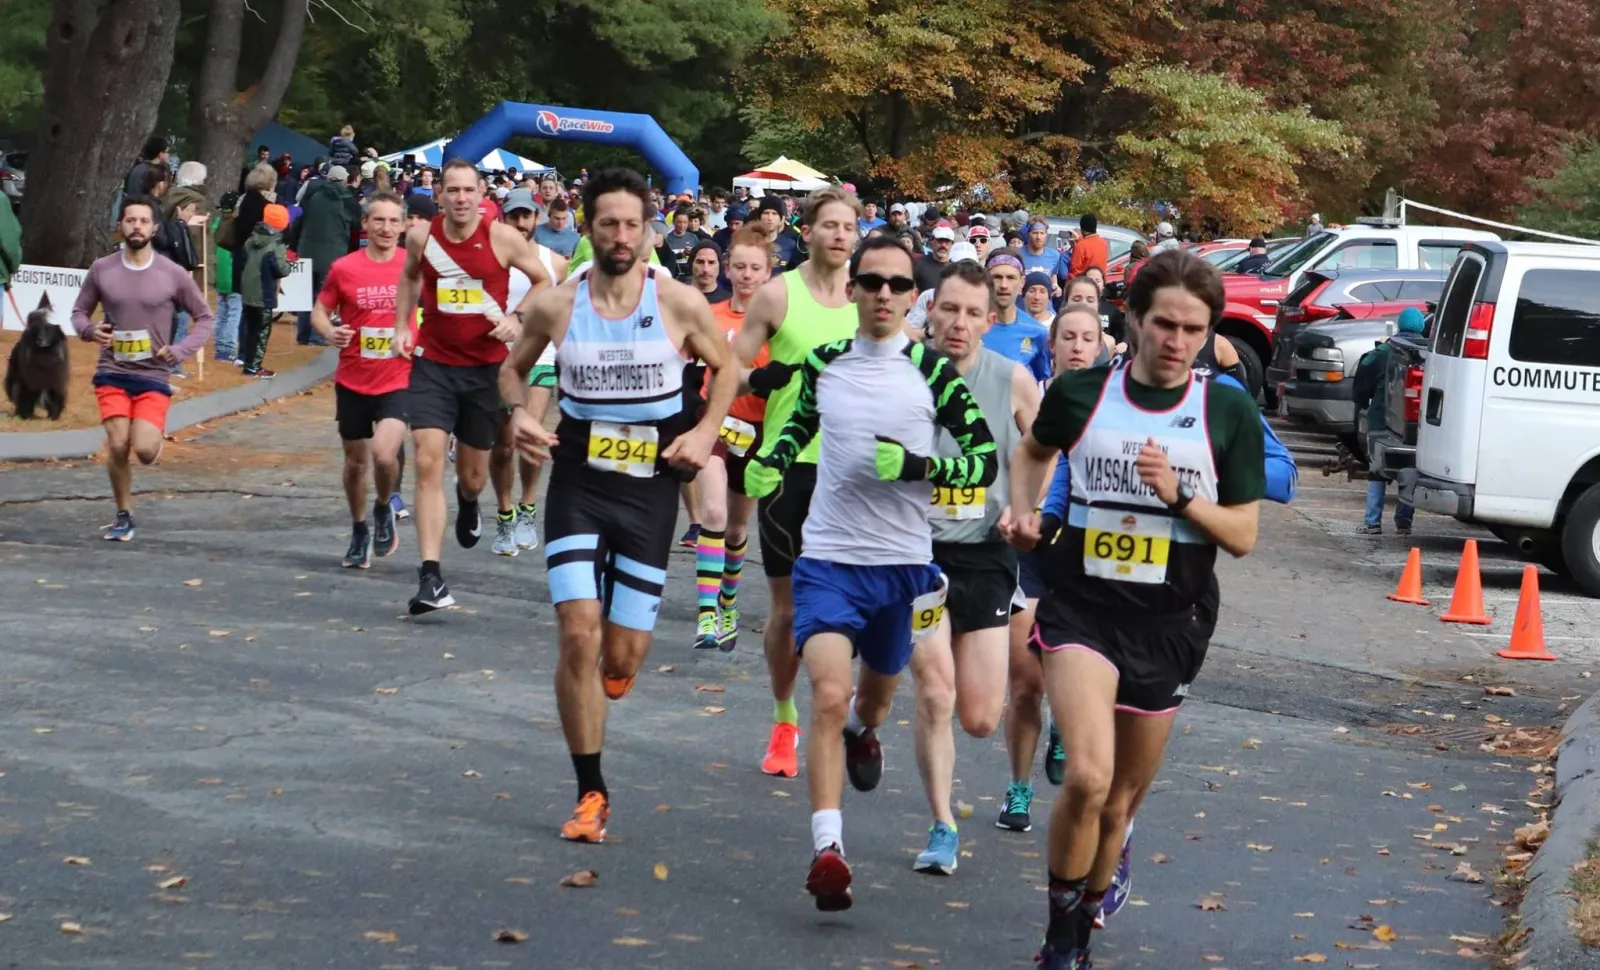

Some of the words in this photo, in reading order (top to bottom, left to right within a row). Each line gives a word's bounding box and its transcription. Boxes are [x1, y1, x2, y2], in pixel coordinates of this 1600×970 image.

[560, 119, 613, 132] RaceWire
[449, 289, 470, 304] 31
[115, 340, 145, 352] 771
[598, 349, 634, 361] WESTERN
[570, 363, 665, 392] MASSACHUSETTS
[598, 437, 648, 463] 294
[1094, 532, 1154, 564] 691
